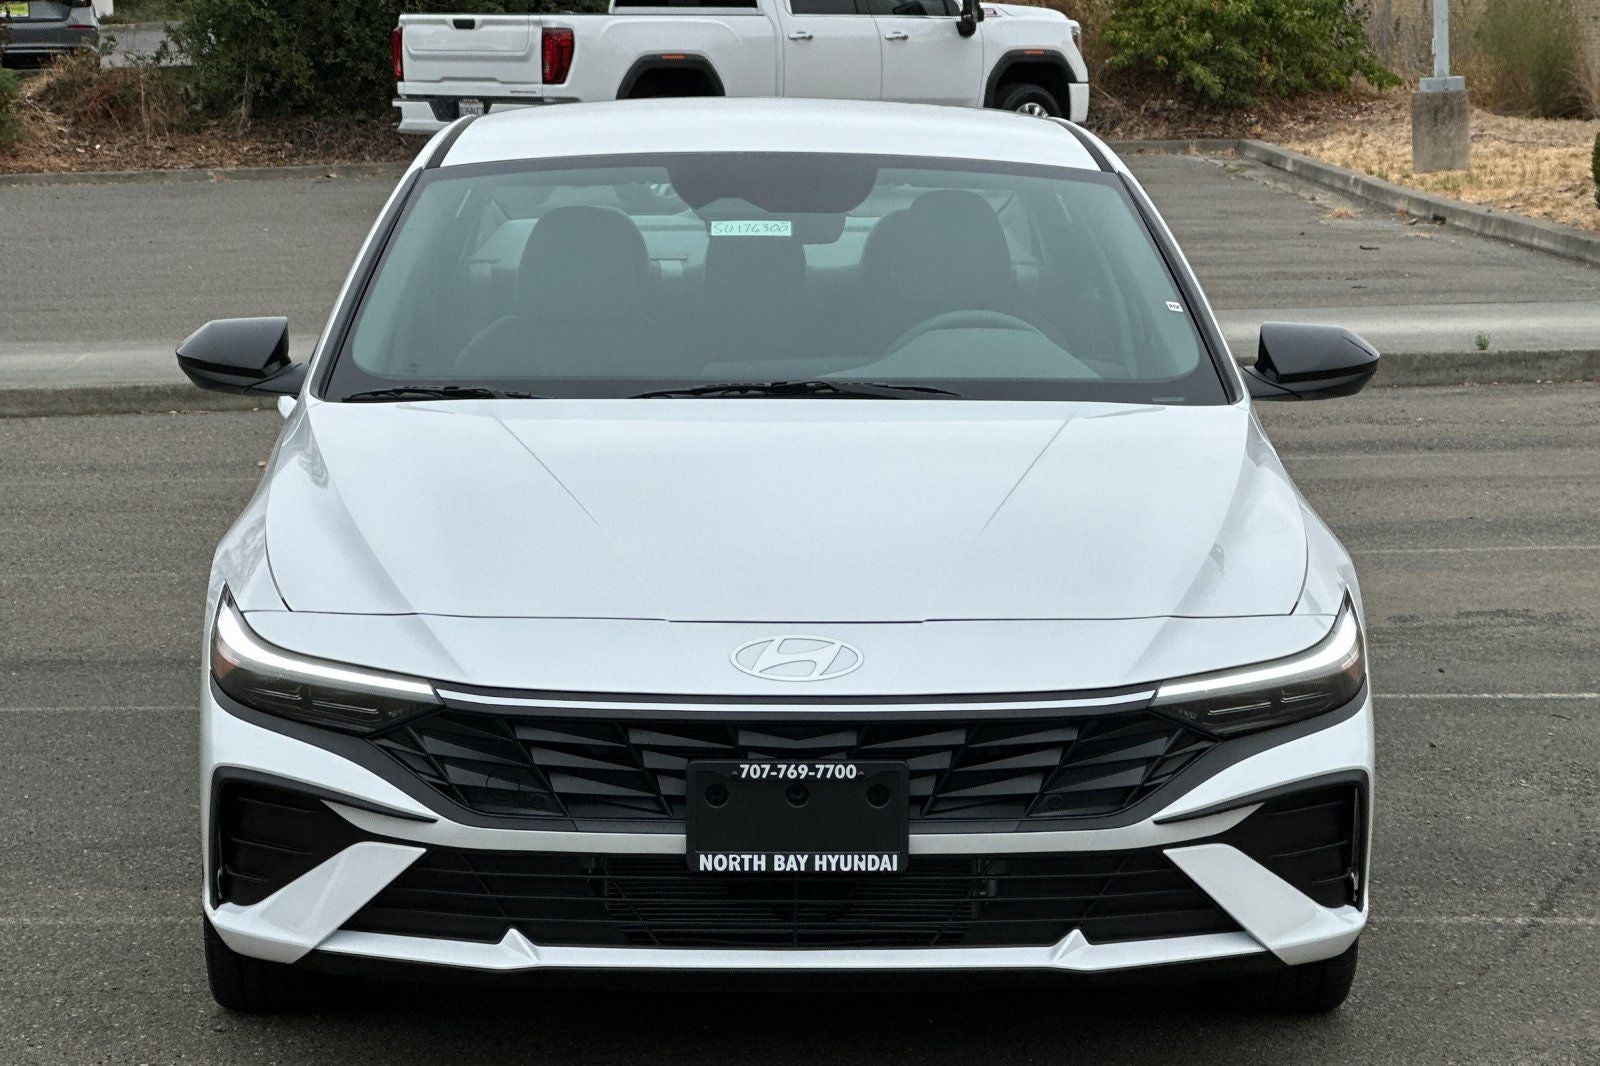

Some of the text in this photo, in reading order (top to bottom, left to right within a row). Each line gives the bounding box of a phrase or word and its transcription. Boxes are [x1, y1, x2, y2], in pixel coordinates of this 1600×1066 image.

[739, 764, 857, 779] 707-769-7700
[699, 854, 898, 872] NORTH BAY HYUNDAI
